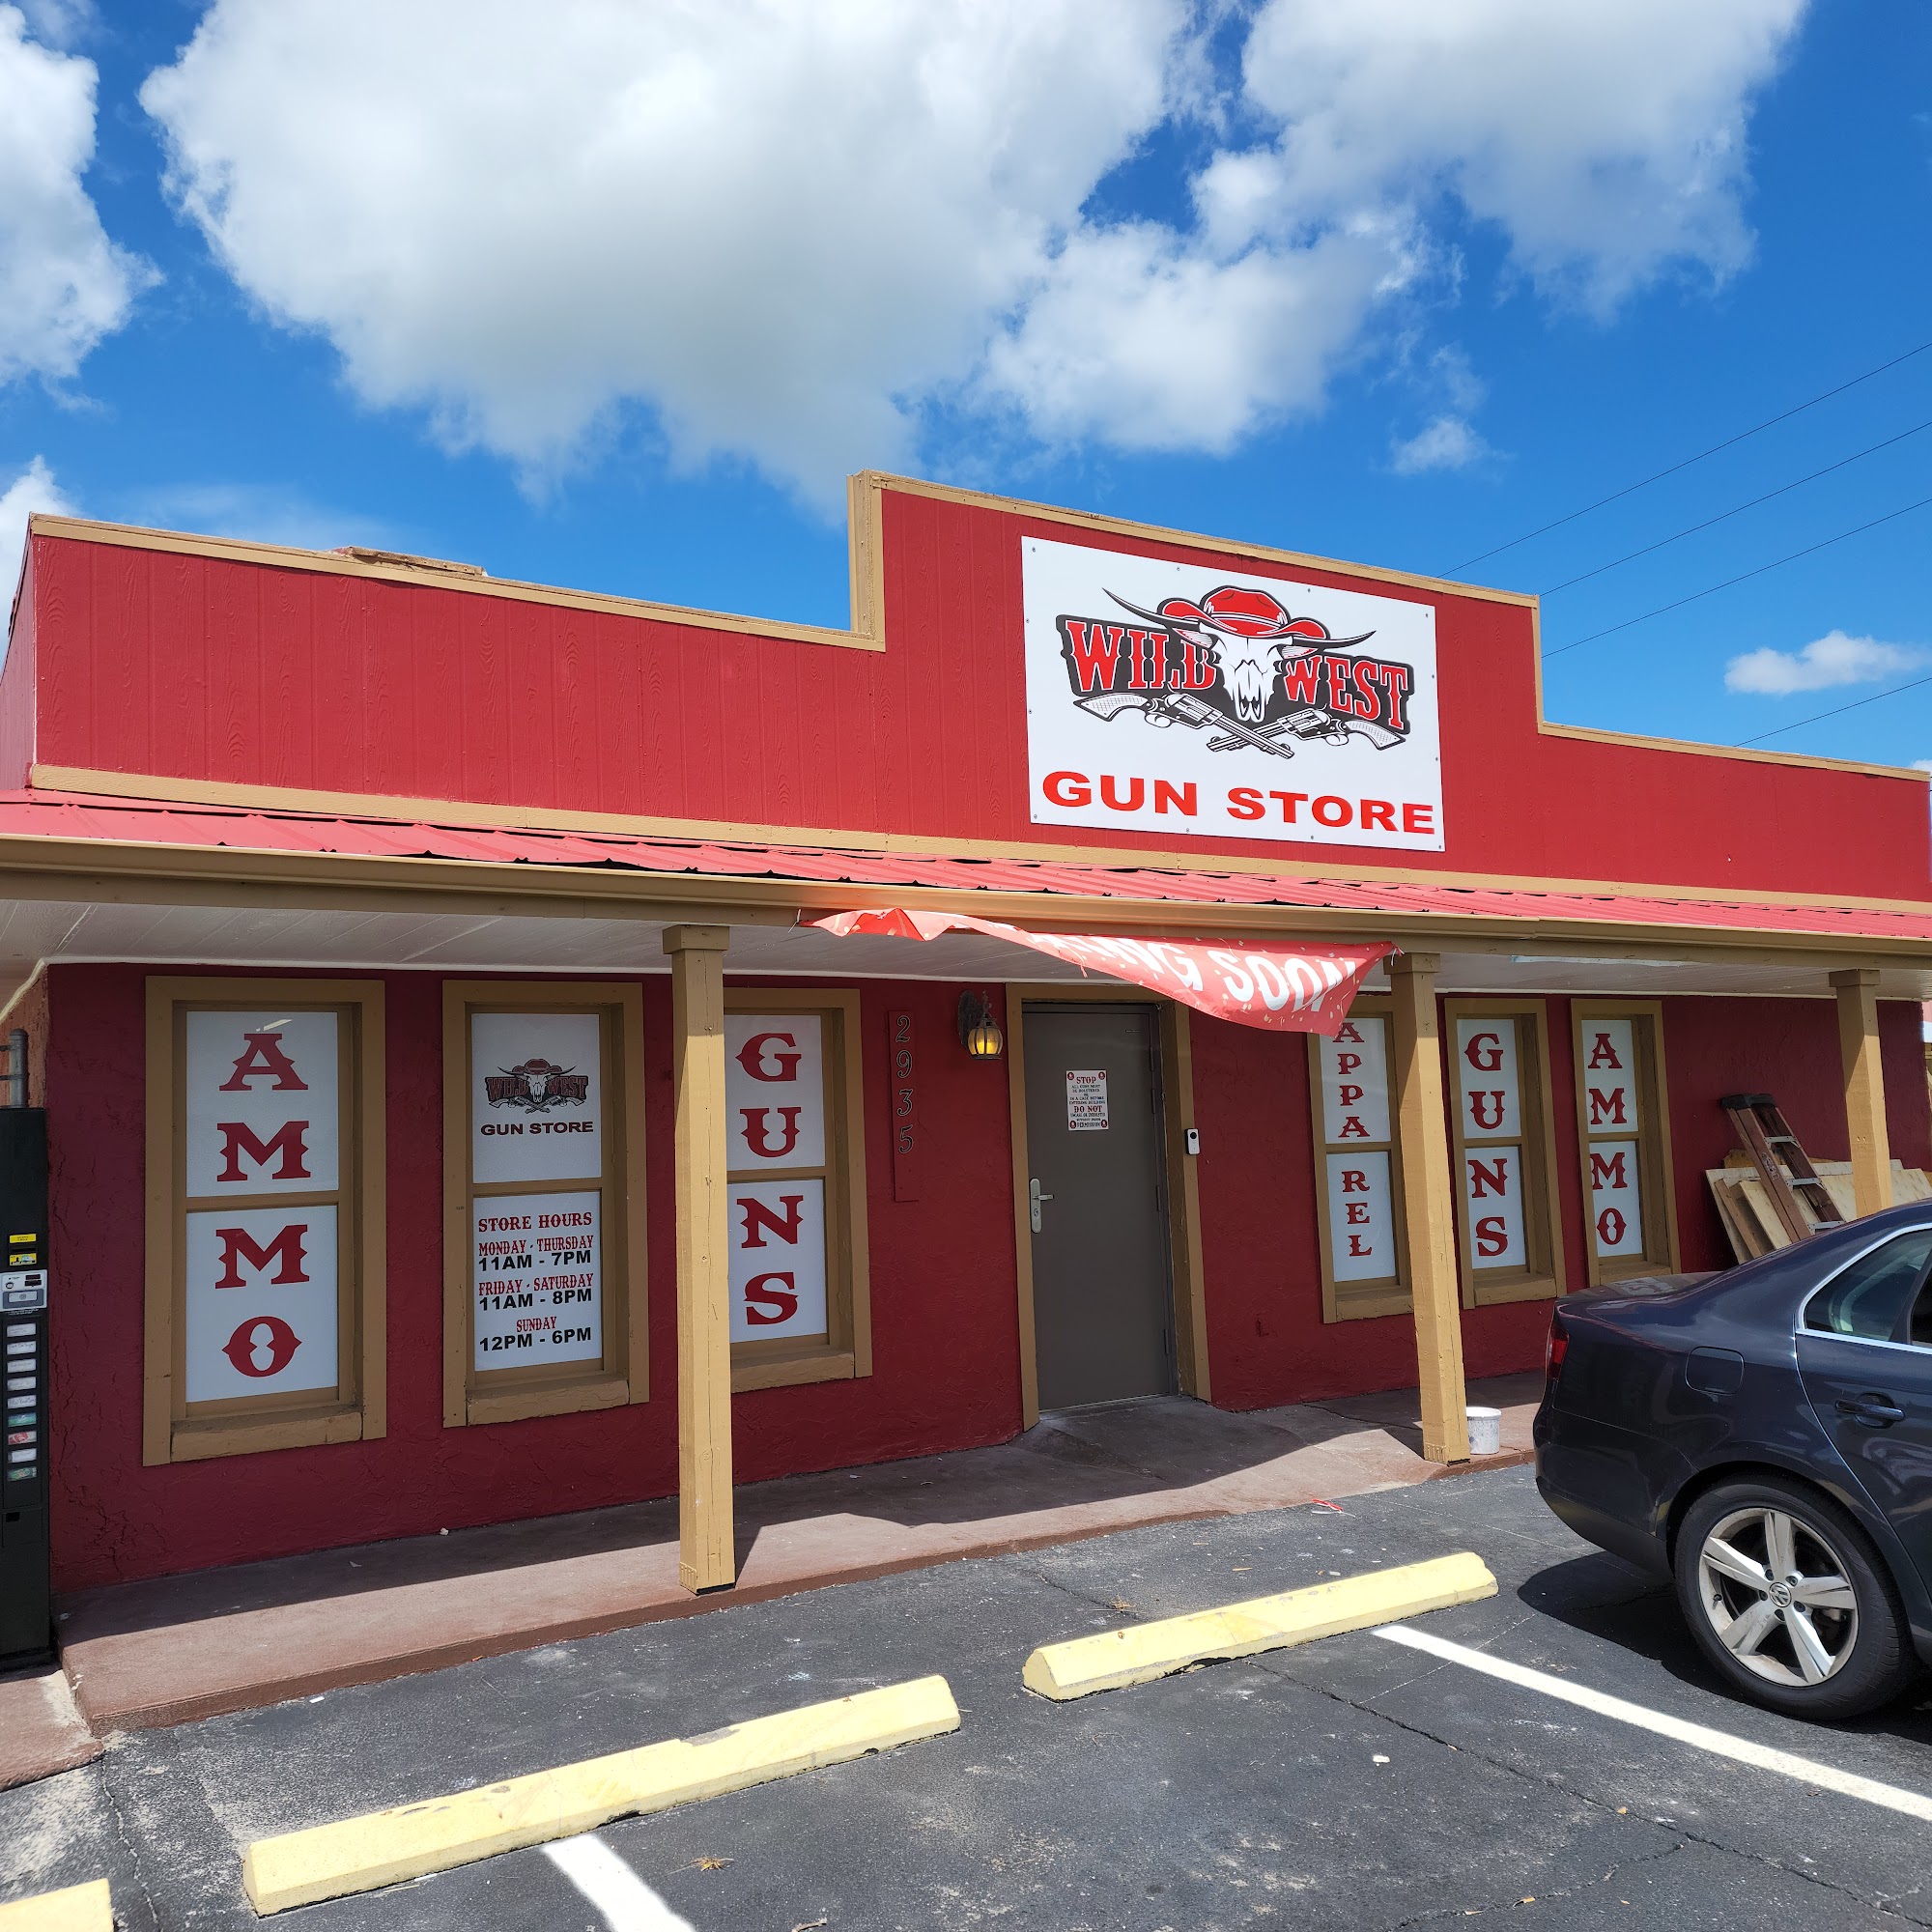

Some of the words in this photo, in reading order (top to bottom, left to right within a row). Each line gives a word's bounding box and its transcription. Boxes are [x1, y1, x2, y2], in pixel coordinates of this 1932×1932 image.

[1065, 619, 1217, 693] WILD
[1282, 654, 1410, 731] WEST
[1042, 771, 1199, 817] GUN
[1226, 787, 1435, 836] STORE
[486, 1077, 529, 1100] WILD
[547, 1076, 587, 1099] WEST
[895, 1015, 914, 1153] 2935
[480, 1123, 524, 1135] GUN
[528, 1122, 594, 1134] STORE
[1332, 1022, 1373, 1257] APPAREL
[1587, 1033, 1628, 1246] AMMO
[1463, 1033, 1509, 1257] GUNS
[735, 1032, 804, 1325] GUNS
[214, 1033, 311, 1378] AMMO
[478, 1216, 532, 1233] STORE
[538, 1212, 592, 1228] HOURS
[478, 1239, 526, 1256] MONDAY
[536, 1235, 594, 1252] THURSDAY
[478, 1254, 532, 1271] 11AM
[551, 1250, 591, 1265] 7PM
[478, 1279, 523, 1295] FRIDAY
[533, 1273, 594, 1292] SATURDAY
[479, 1293, 533, 1311] 11AM
[552, 1288, 592, 1304] 8PM
[516, 1316, 557, 1332] SUNDAY
[479, 1333, 532, 1351] 12PM
[552, 1327, 591, 1344] 6PM
